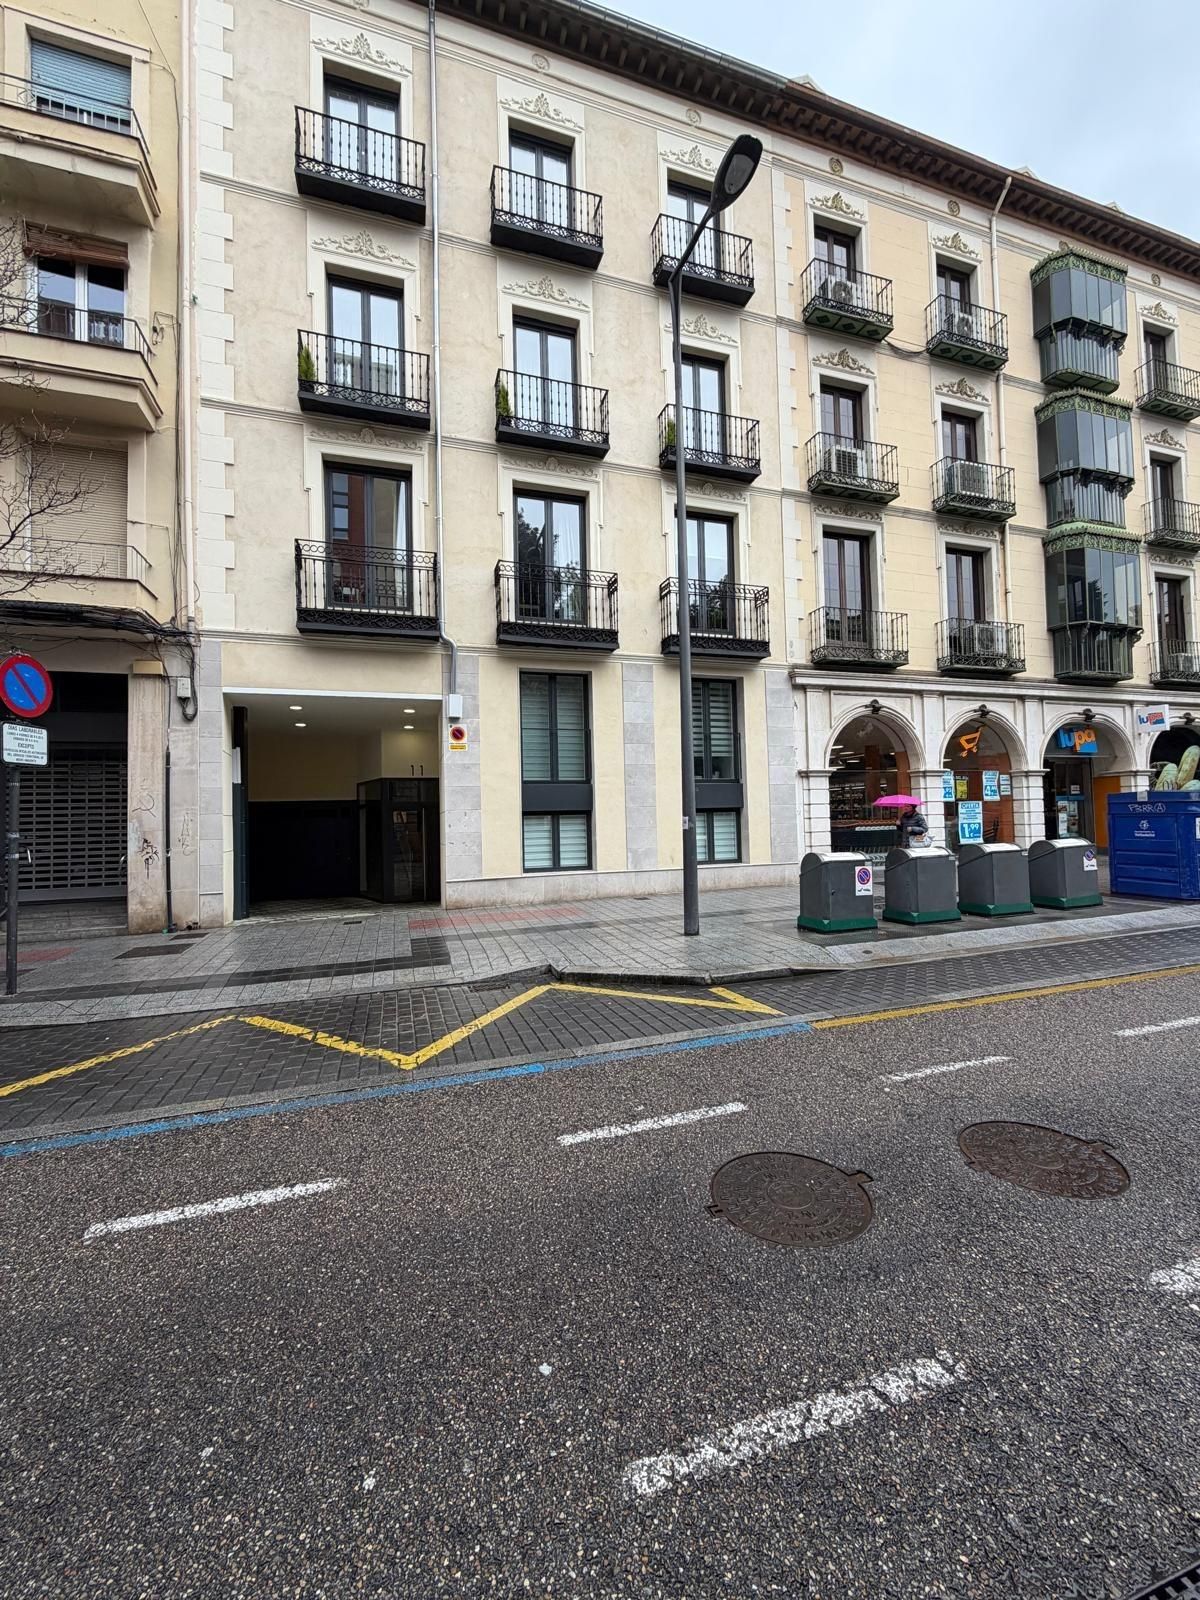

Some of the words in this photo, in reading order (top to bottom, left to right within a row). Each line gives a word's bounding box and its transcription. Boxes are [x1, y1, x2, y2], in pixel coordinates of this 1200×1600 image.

[1138, 712, 1164, 725] lupa
[1058, 728, 1096, 752] lupa
[410, 764, 424, 777] 11
